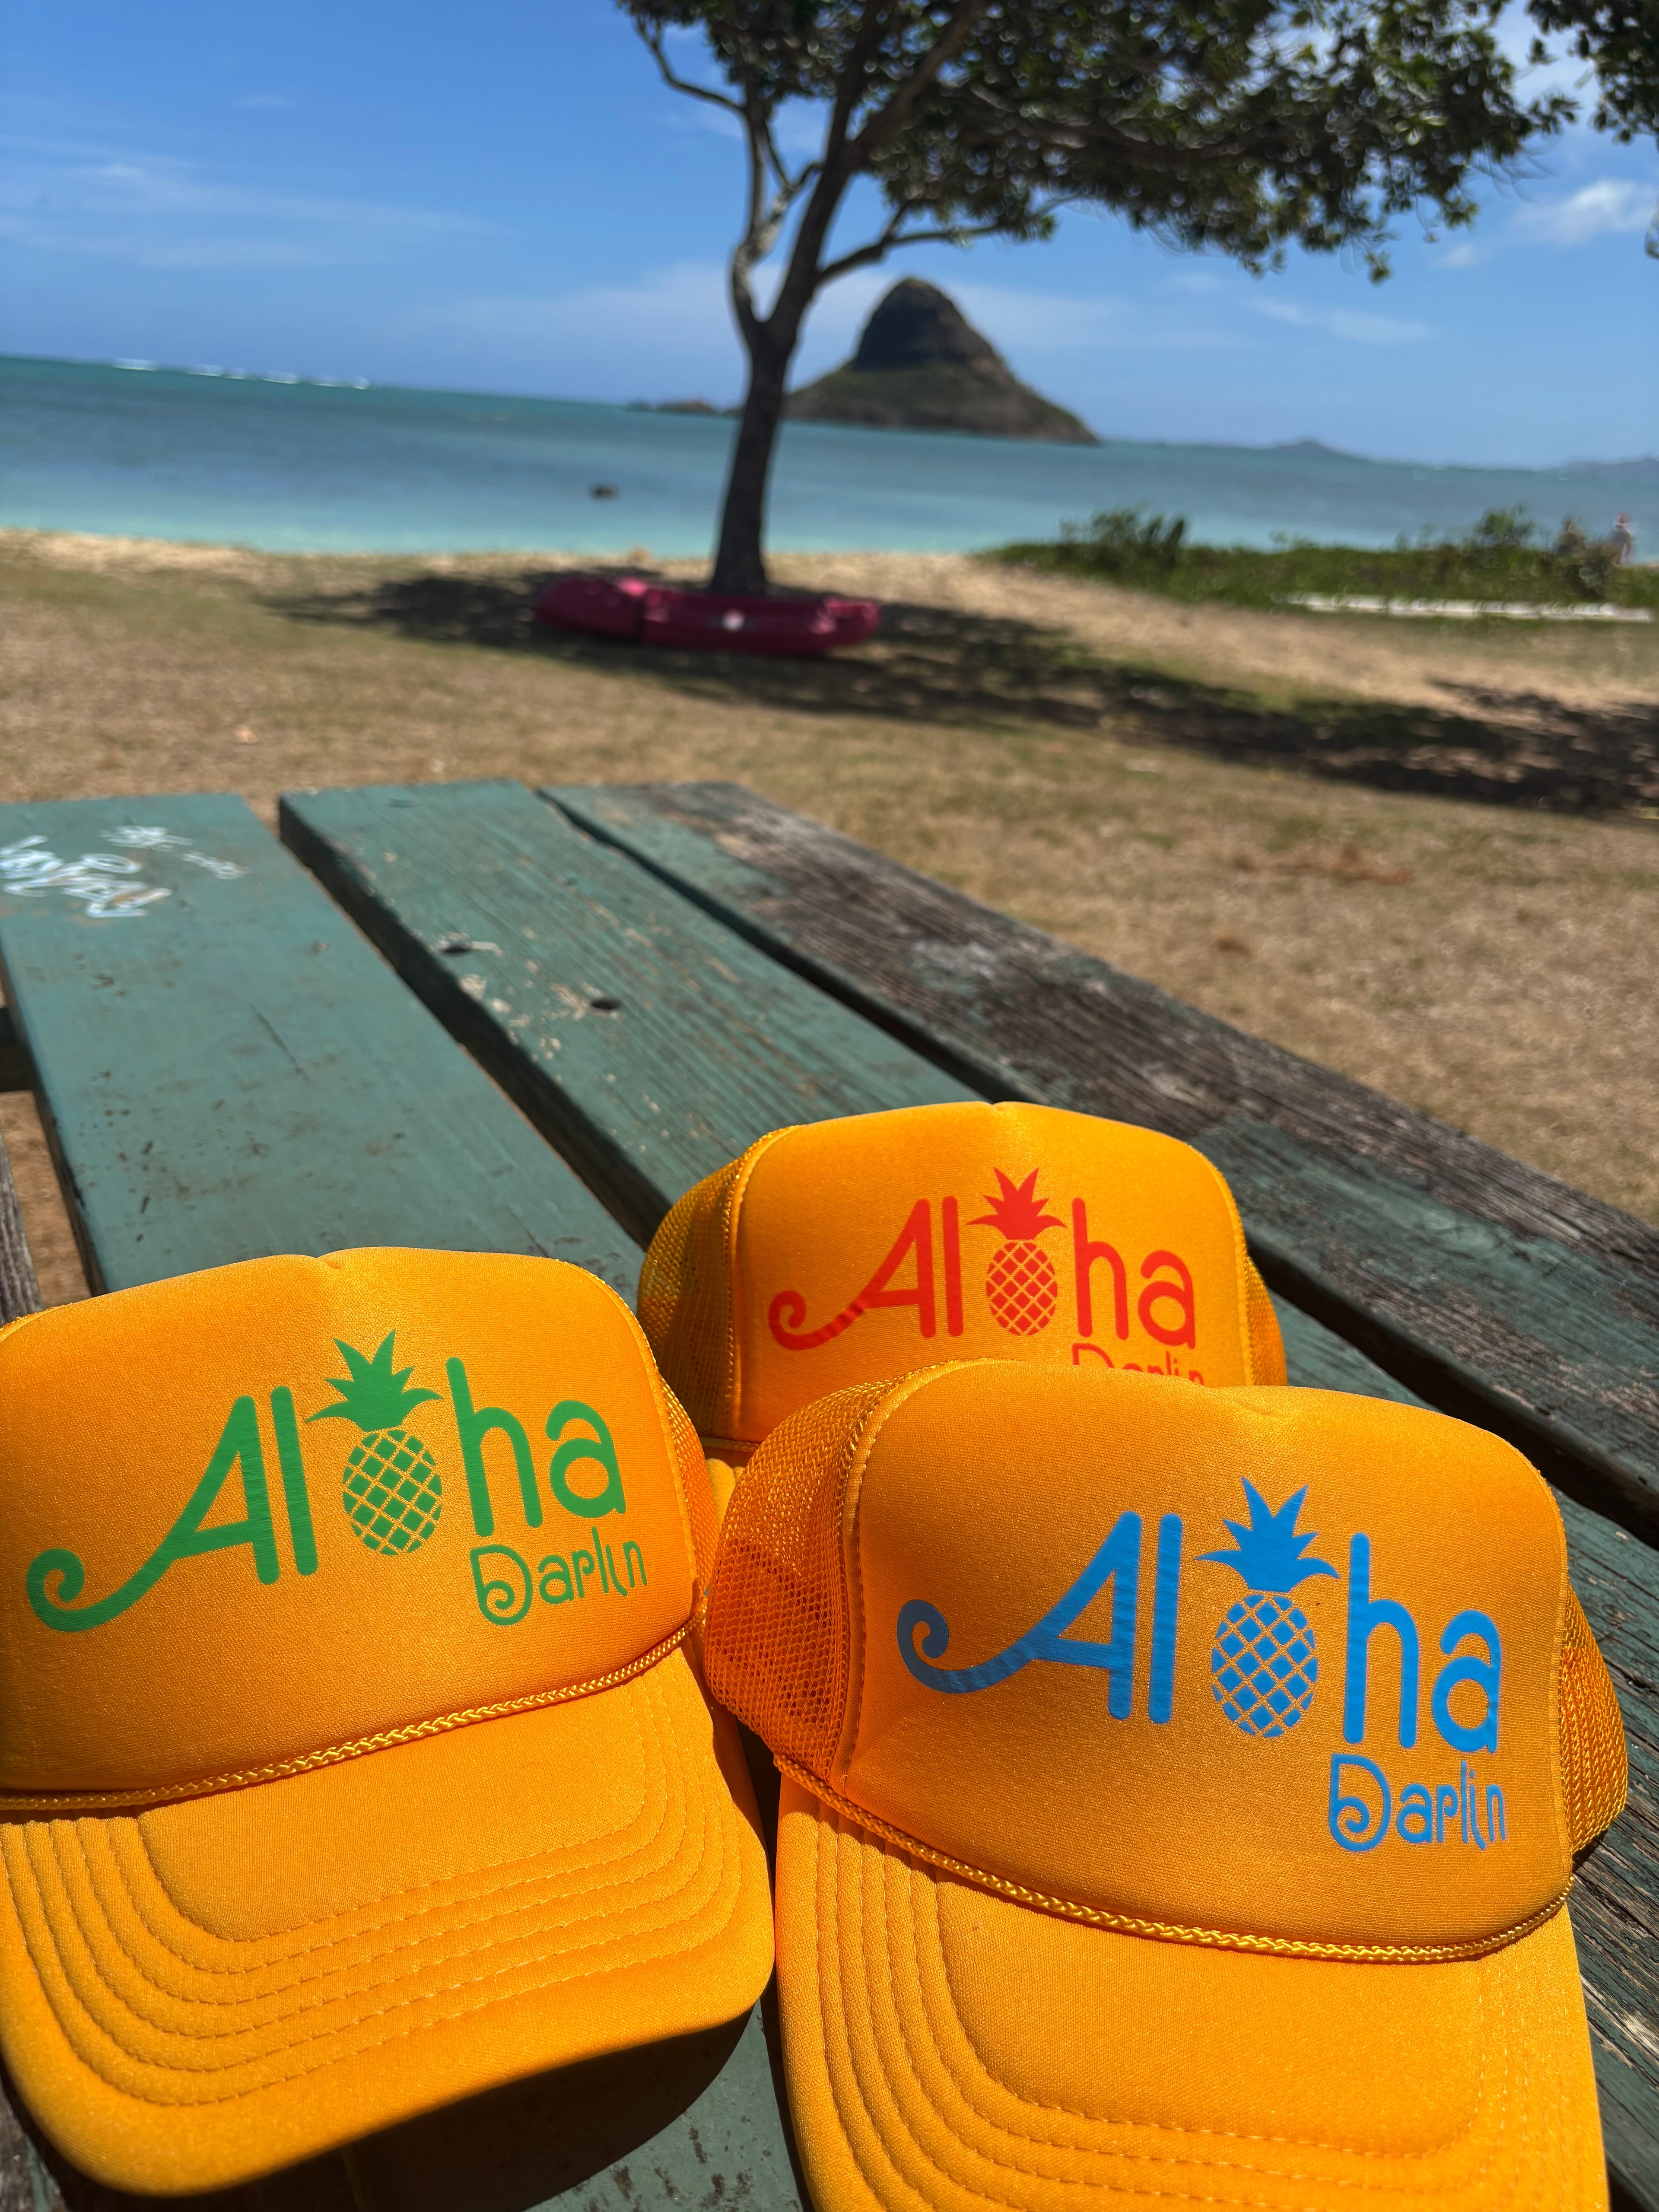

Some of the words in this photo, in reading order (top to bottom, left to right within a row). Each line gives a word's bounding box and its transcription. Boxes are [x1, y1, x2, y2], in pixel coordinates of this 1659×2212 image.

[769, 1168, 1196, 1351] Aloha
[27, 1330, 626, 1632] Aloha
[470, 1527, 647, 1626] Darlin
[896, 1478, 1502, 1754] Aloha
[1328, 1754, 1507, 1852] Darlin
